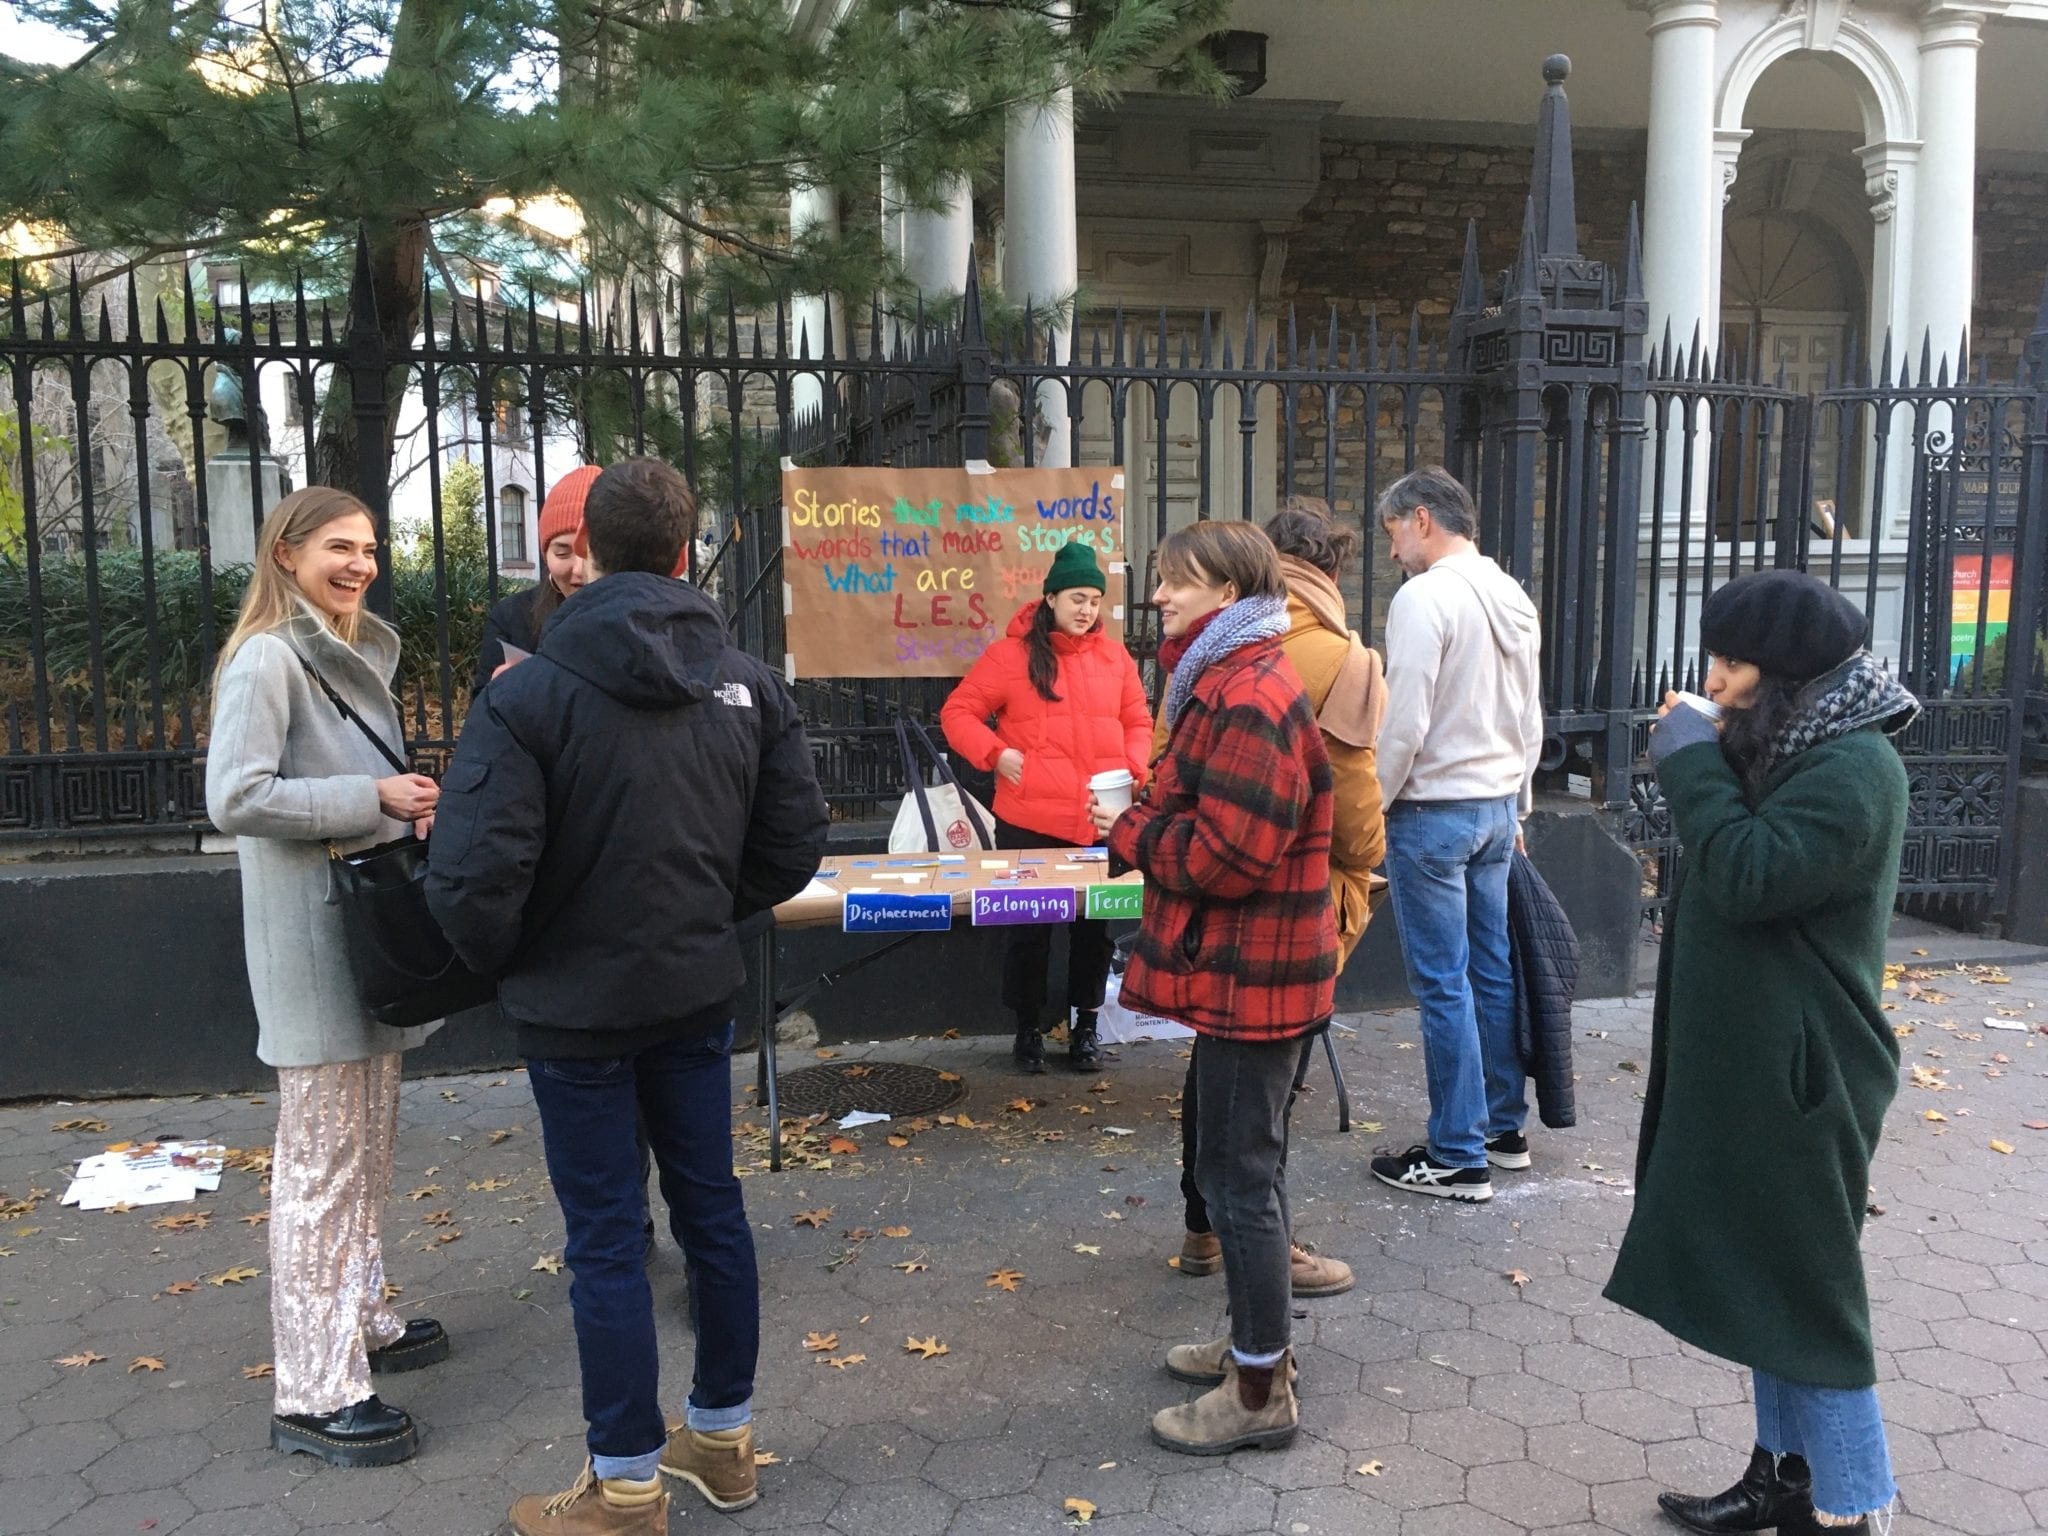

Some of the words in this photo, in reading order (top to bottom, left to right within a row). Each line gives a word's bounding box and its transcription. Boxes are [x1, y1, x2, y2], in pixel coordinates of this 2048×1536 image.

[793, 488, 881, 528] Stories
[890, 496, 943, 527] that
[955, 495, 1016, 524] make
[1035, 480, 1116, 523] words,
[793, 527, 872, 560] words
[880, 530, 930, 557] that
[942, 528, 1003, 555] make
[823, 562, 898, 594] What
[916, 567, 975, 592] are
[894, 592, 995, 630] L.E.S.
[713, 689, 740, 699] NORTH
[723, 682, 740, 691] THE
[723, 697, 742, 706] FACE
[976, 895, 1069, 919] Belonging
[1090, 890, 1139, 912] Terri
[848, 904, 950, 924] Displacement
